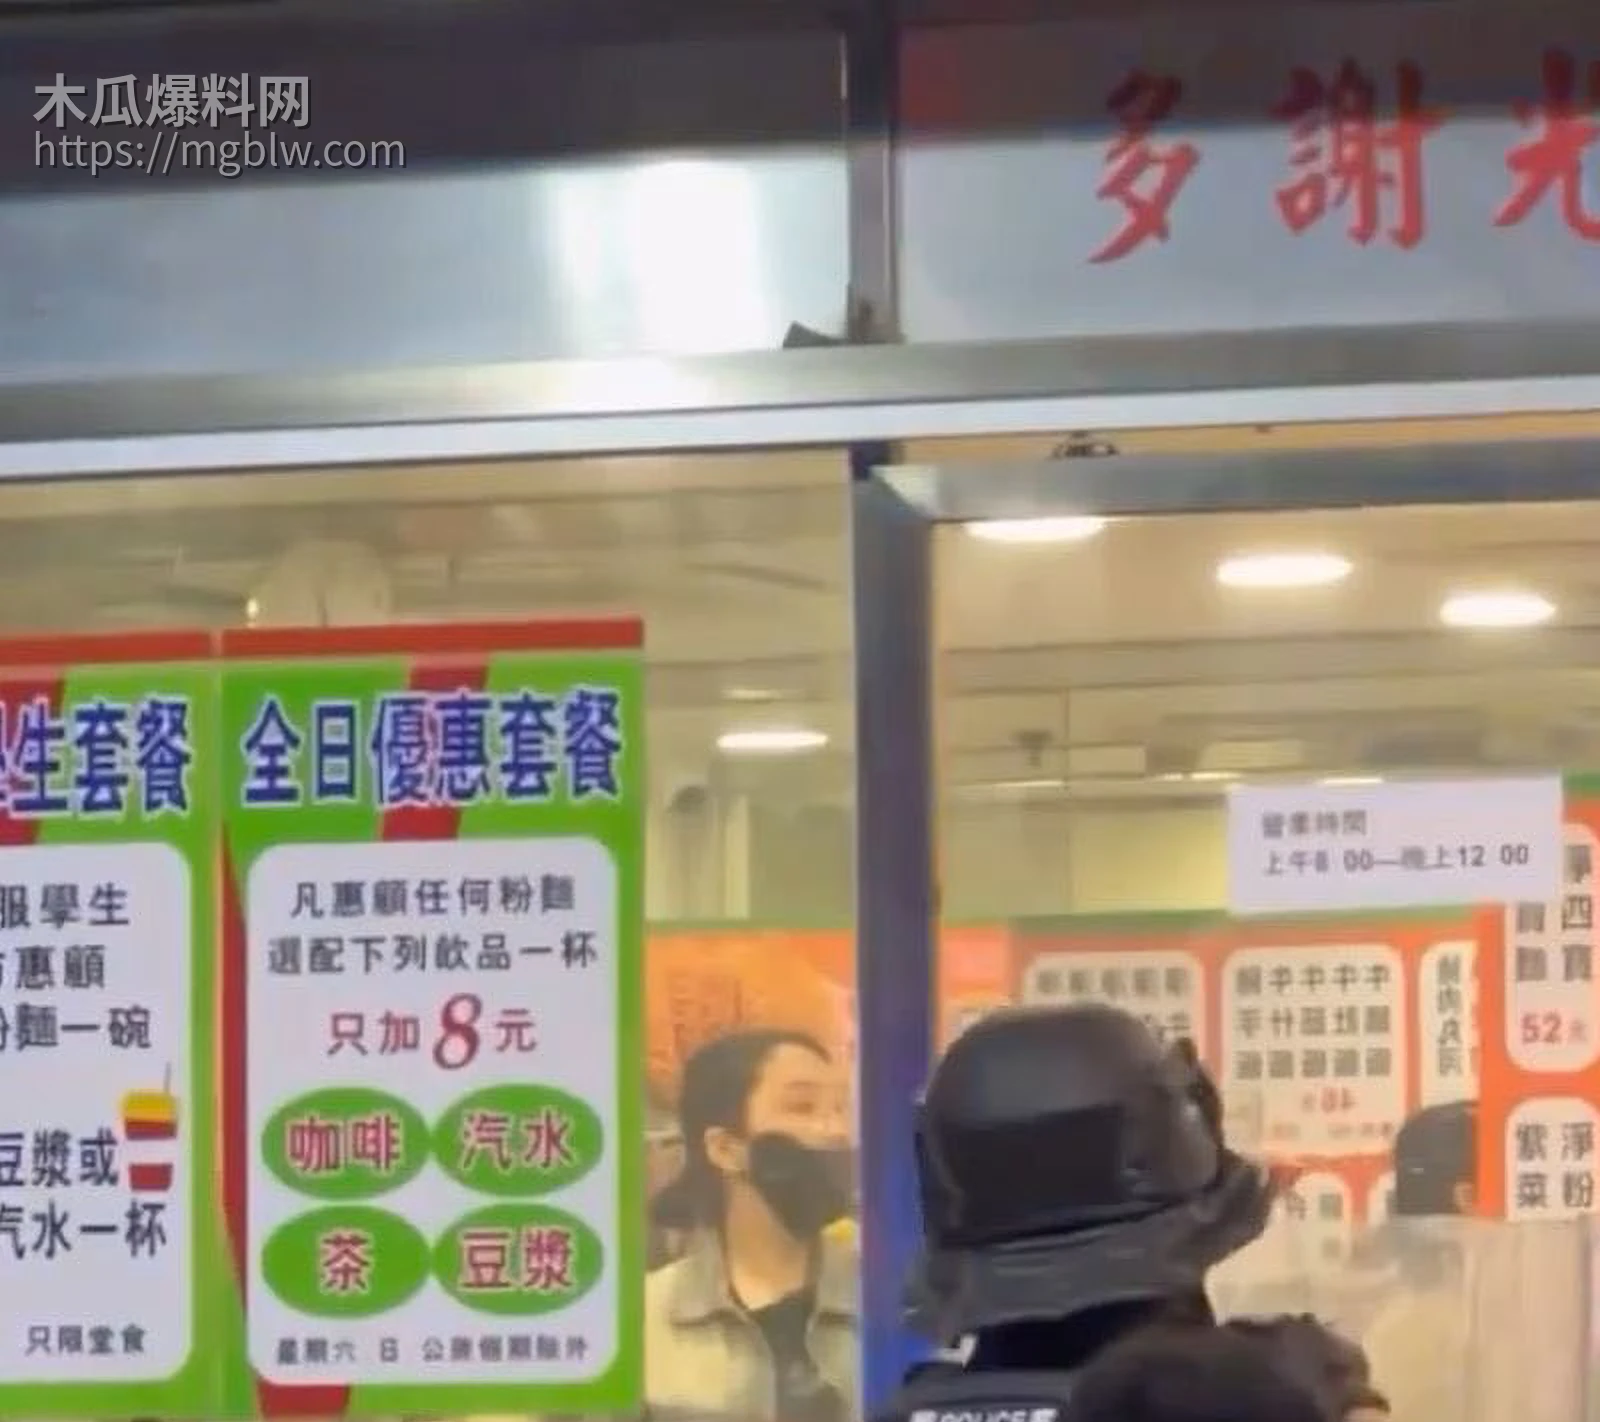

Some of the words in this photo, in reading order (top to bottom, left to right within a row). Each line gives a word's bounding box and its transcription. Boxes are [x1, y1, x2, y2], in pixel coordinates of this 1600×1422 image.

[0, 700, 191, 812] 生套餐
[245, 690, 620, 804] 全日優惠套餐
[291, 873, 575, 918] 凡惠顧任何粉麵
[0, 944, 105, 990] 惠顧
[268, 928, 598, 975] 選配下列飲品一杯
[0, 1002, 152, 1051] 麵一碗
[327, 992, 538, 1070] 只加8元
[287, 1116, 399, 1173] 咖啡
[463, 1115, 572, 1169] 汽水
[322, 1235, 370, 1292] 茶
[461, 1231, 572, 1290] 豆漿
[25, 1322, 146, 1357] 只限堂食
